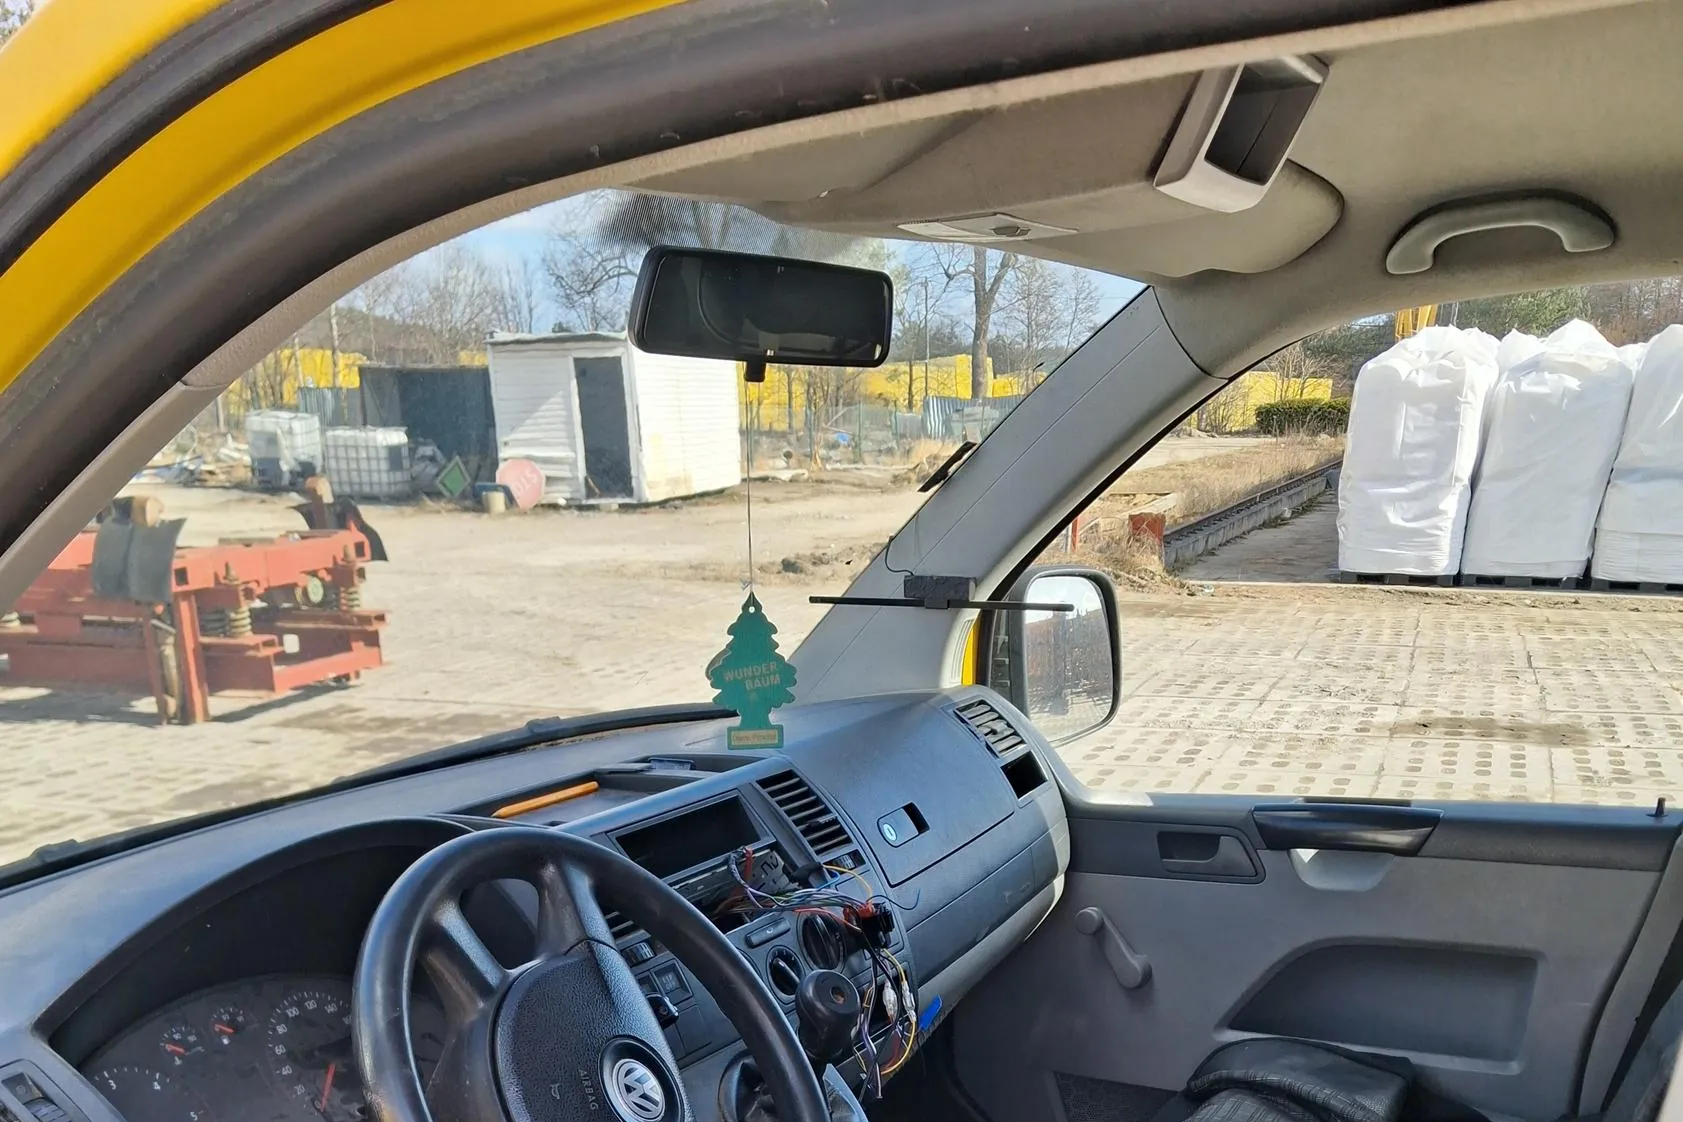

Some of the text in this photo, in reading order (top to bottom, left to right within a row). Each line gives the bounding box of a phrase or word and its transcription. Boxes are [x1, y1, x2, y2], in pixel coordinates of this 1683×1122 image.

[723, 661, 776, 682] WUNDER
[745, 674, 780, 691] BAUM
[304, 1000, 317, 1010] 120
[324, 1003, 338, 1014] 140
[285, 1007, 299, 1018] 100
[276, 1024, 288, 1035] 80
[275, 1044, 286, 1055] 60
[281, 1065, 292, 1075] 40
[108, 1079, 117, 1091] 3
[153, 1081, 161, 1091] 4
[294, 1084, 305, 1095] 20
[578, 1069, 599, 1111] AIRBAG
[190, 1111, 198, 1121] 5
